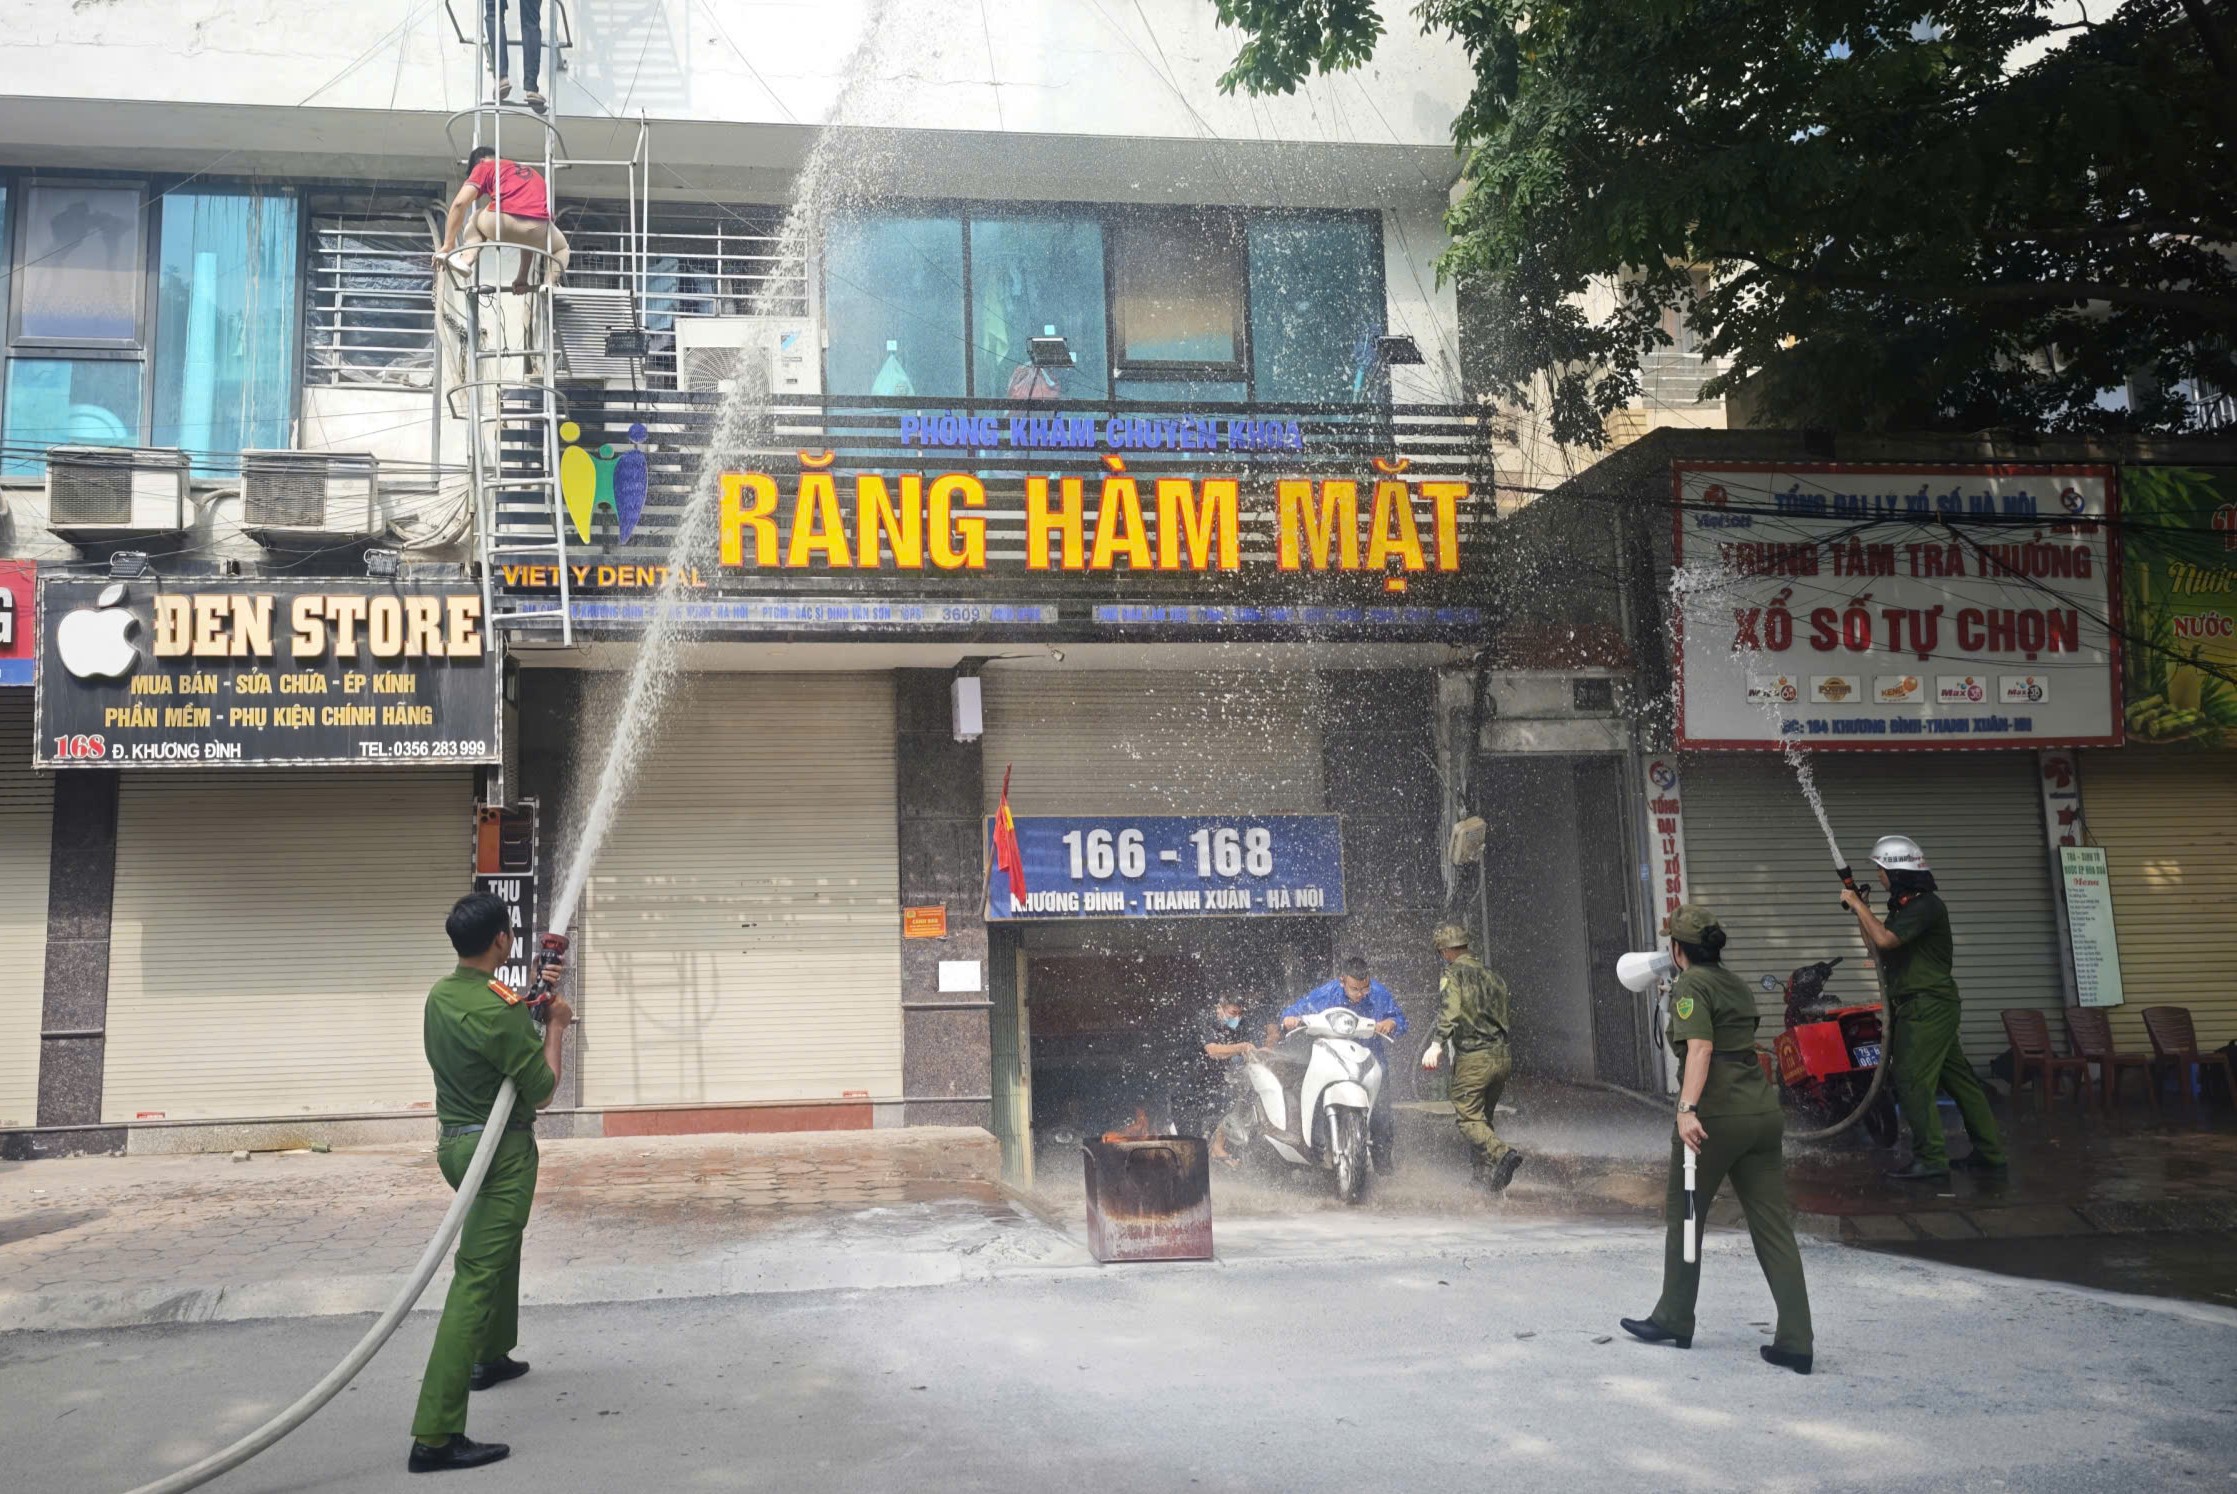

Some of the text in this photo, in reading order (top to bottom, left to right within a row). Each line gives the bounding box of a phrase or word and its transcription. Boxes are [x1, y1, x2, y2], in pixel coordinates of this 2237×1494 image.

[1009, 411, 1095, 449] KHÁM
[1228, 420, 1304, 450] KHOA
[717, 449, 1470, 592] RĂNG HÀM MẶT
[1832, 535, 1895, 577] TÂM
[571, 565, 591, 587] Y
[597, 565, 708, 588] DENTAL
[152, 594, 483, 658] ĐEN STORE
[942, 607, 980, 621] 3609
[1732, 586, 2080, 661] XỔ SỐ TỰ CHỌN
[2173, 610, 2234, 637] NƯỚC
[130, 674, 173, 695] MUA
[178, 670, 218, 694] BÁN
[236, 667, 273, 695] SỬA
[279, 668, 328, 694] CHỮA
[343, 670, 367, 694] ÉP
[372, 670, 416, 694] KÍNH
[104, 701, 157, 728] PHẦN
[165, 701, 210, 727] MỀM
[229, 707, 267, 730] PHỤ
[273, 703, 315, 730] KIỆN
[321, 702, 376, 726] CHÍNH
[382, 701, 433, 726] HÃNG
[53, 734, 242, 759] 168 Đ. KHƯƠNG ĐÌNH
[431, 740, 458, 756] 283
[459, 740, 486, 756] 999
[1063, 828, 1145, 879] 166
[1189, 827, 1273, 878] 168
[1083, 886, 1125, 911] ĐÌNH
[1143, 890, 1201, 911] THANH
[1204, 887, 1251, 911] XUÂN
[1266, 885, 1291, 910] HÀ
[1295, 884, 1324, 912] NỘI
